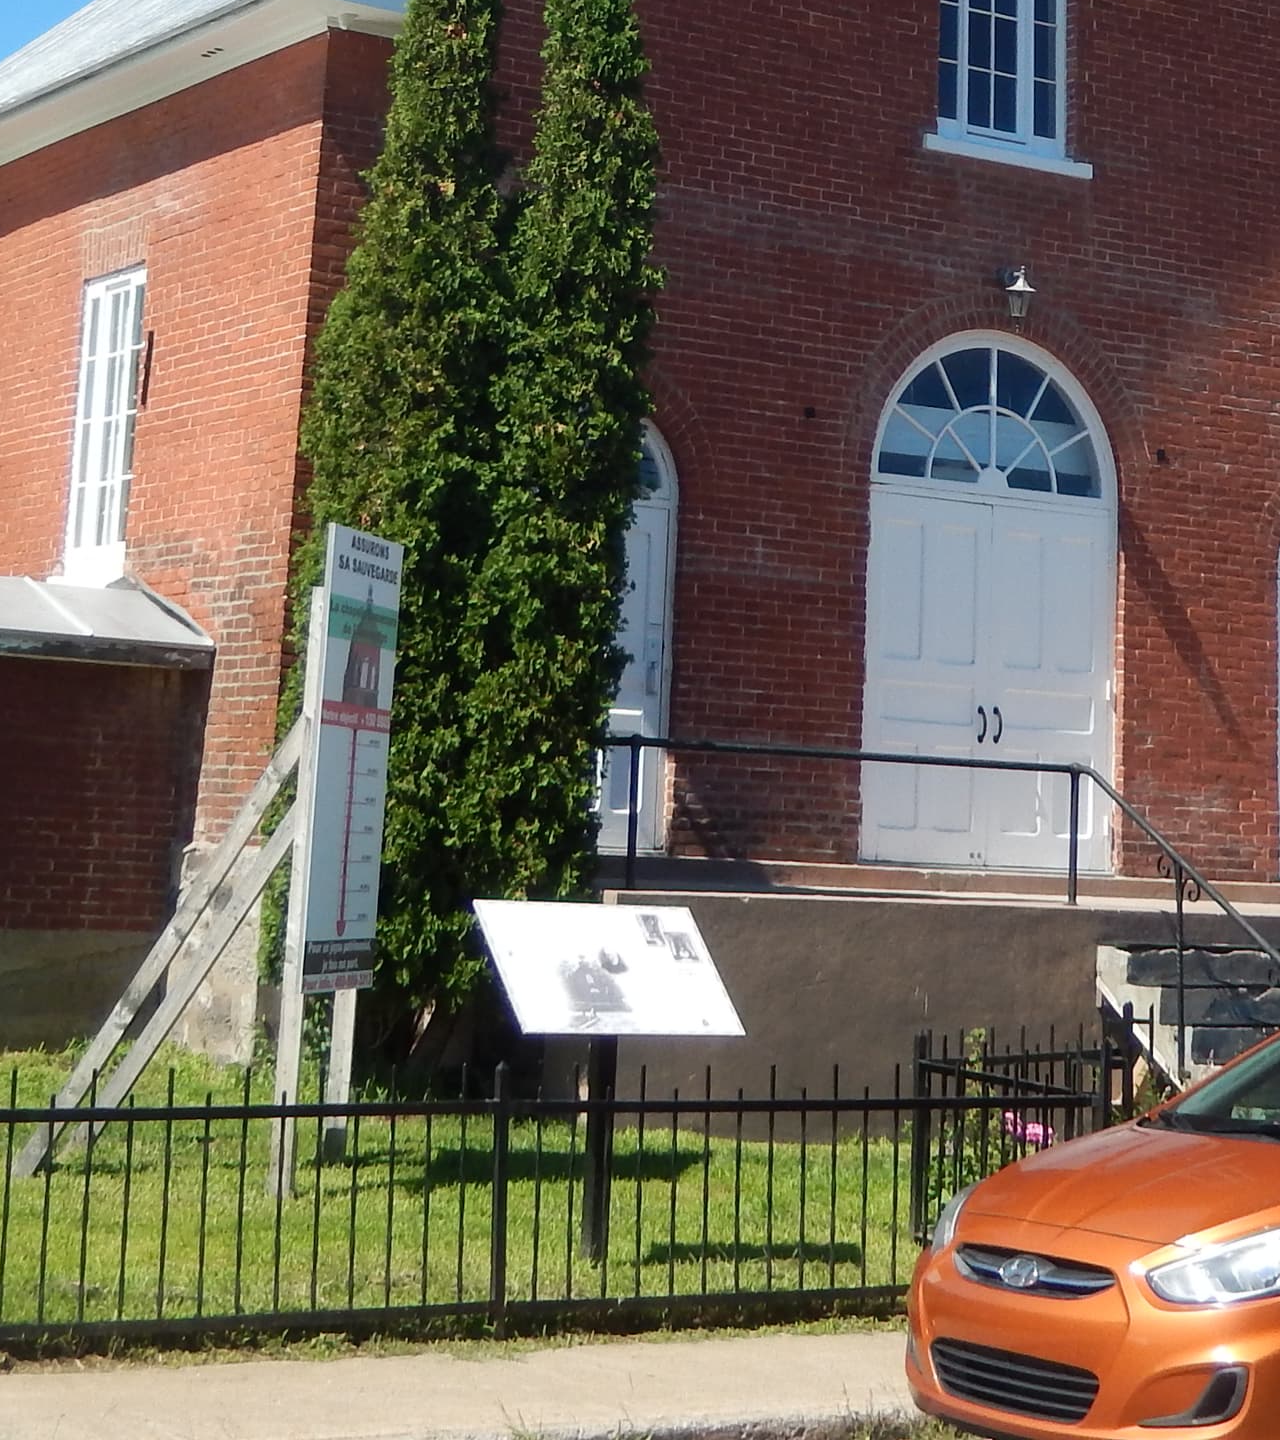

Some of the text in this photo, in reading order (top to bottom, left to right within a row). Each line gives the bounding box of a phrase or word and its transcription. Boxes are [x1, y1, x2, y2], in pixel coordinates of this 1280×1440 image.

[351, 535, 389, 560] ASSURONS
[339, 554, 398, 585] SA SAUVEGARDE
